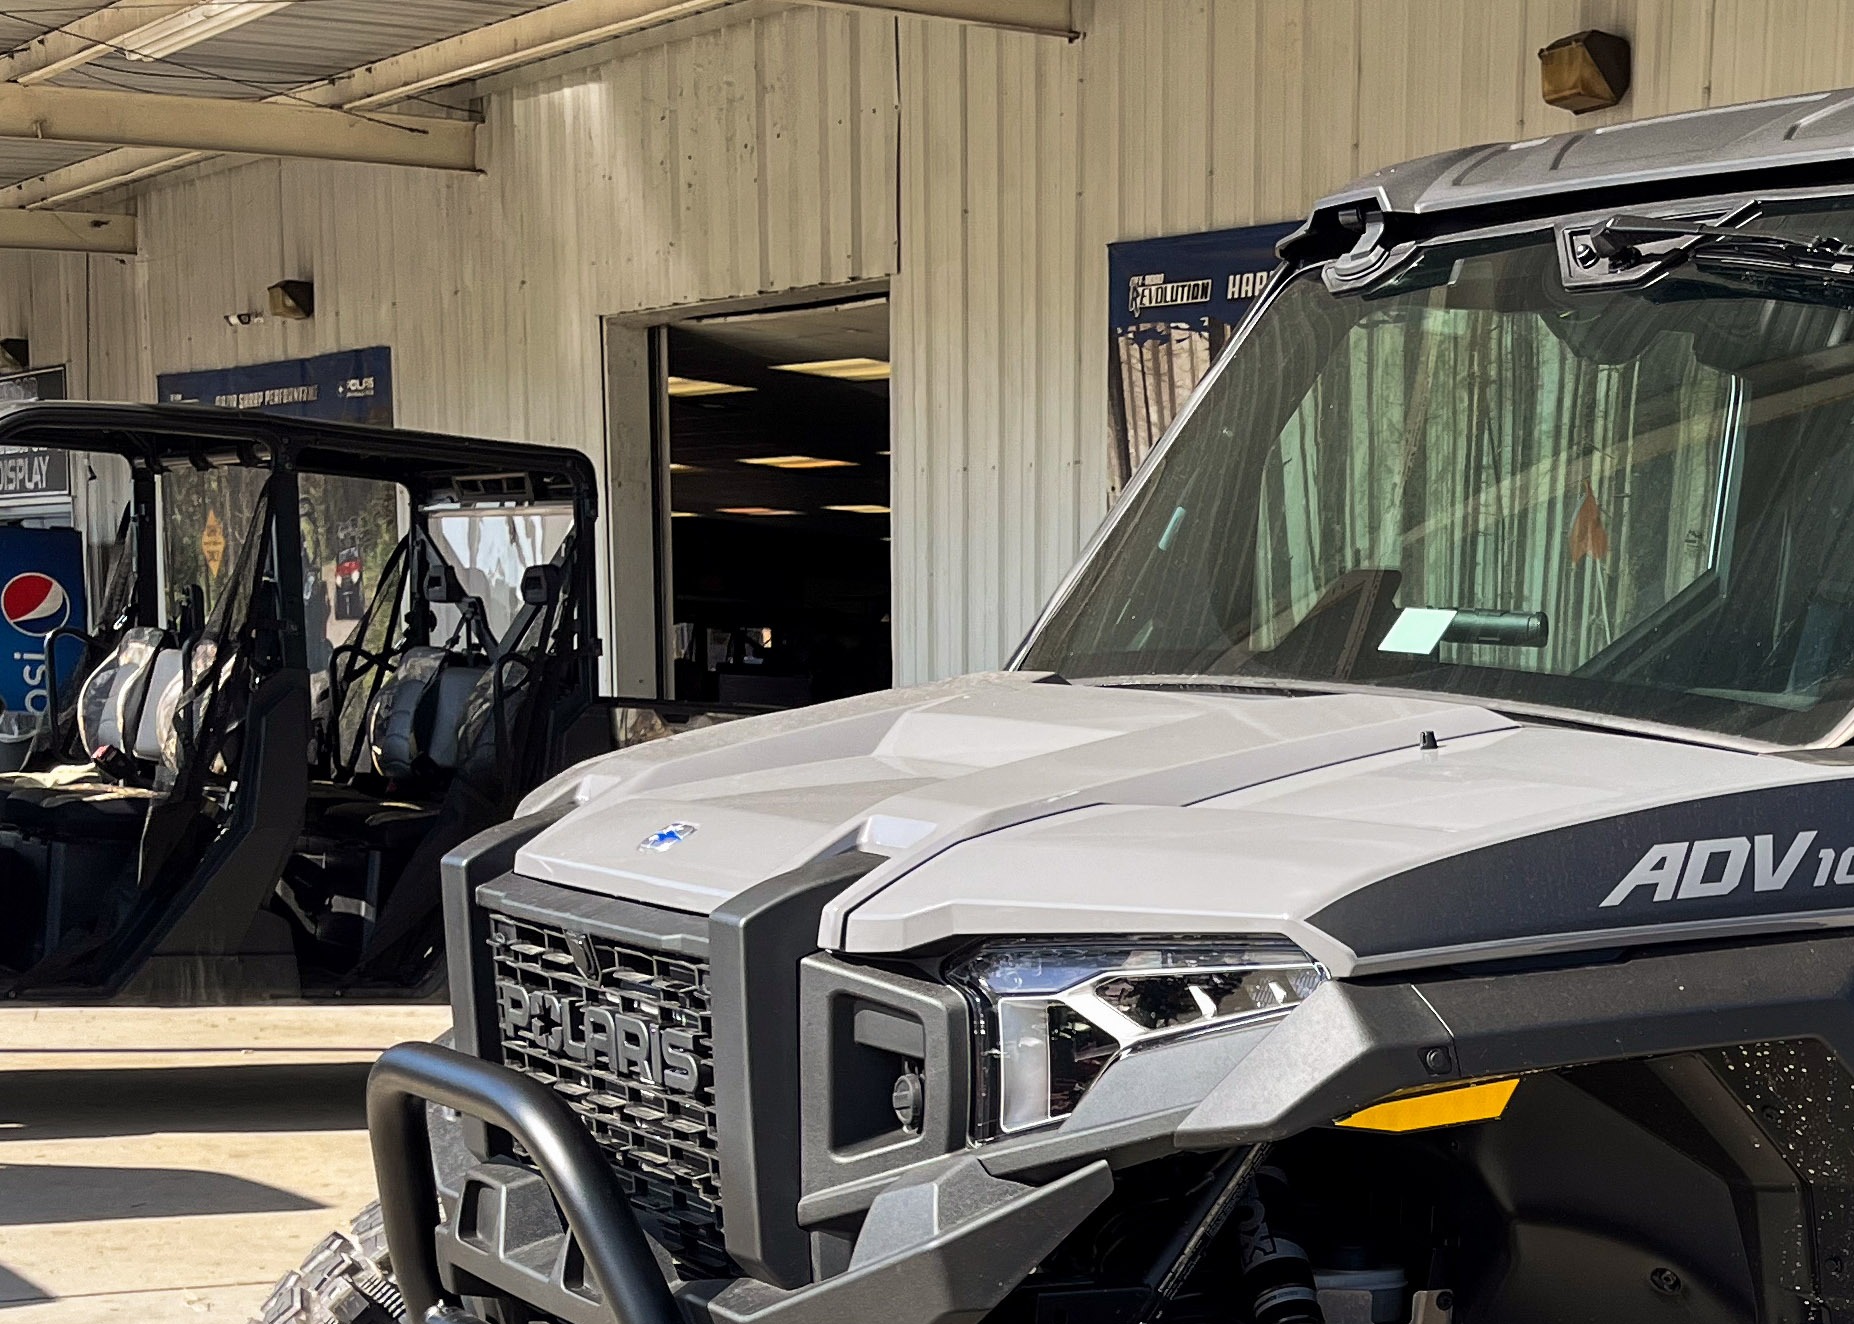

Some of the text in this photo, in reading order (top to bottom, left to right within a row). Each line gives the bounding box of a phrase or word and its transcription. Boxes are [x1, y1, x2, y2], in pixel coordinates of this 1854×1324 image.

[1128, 279, 1213, 318] REVOLUTION
[0, 455, 50, 491] ISPLAY
[1598, 830, 1819, 908] ADV
[499, 981, 699, 1094] POLARIS
